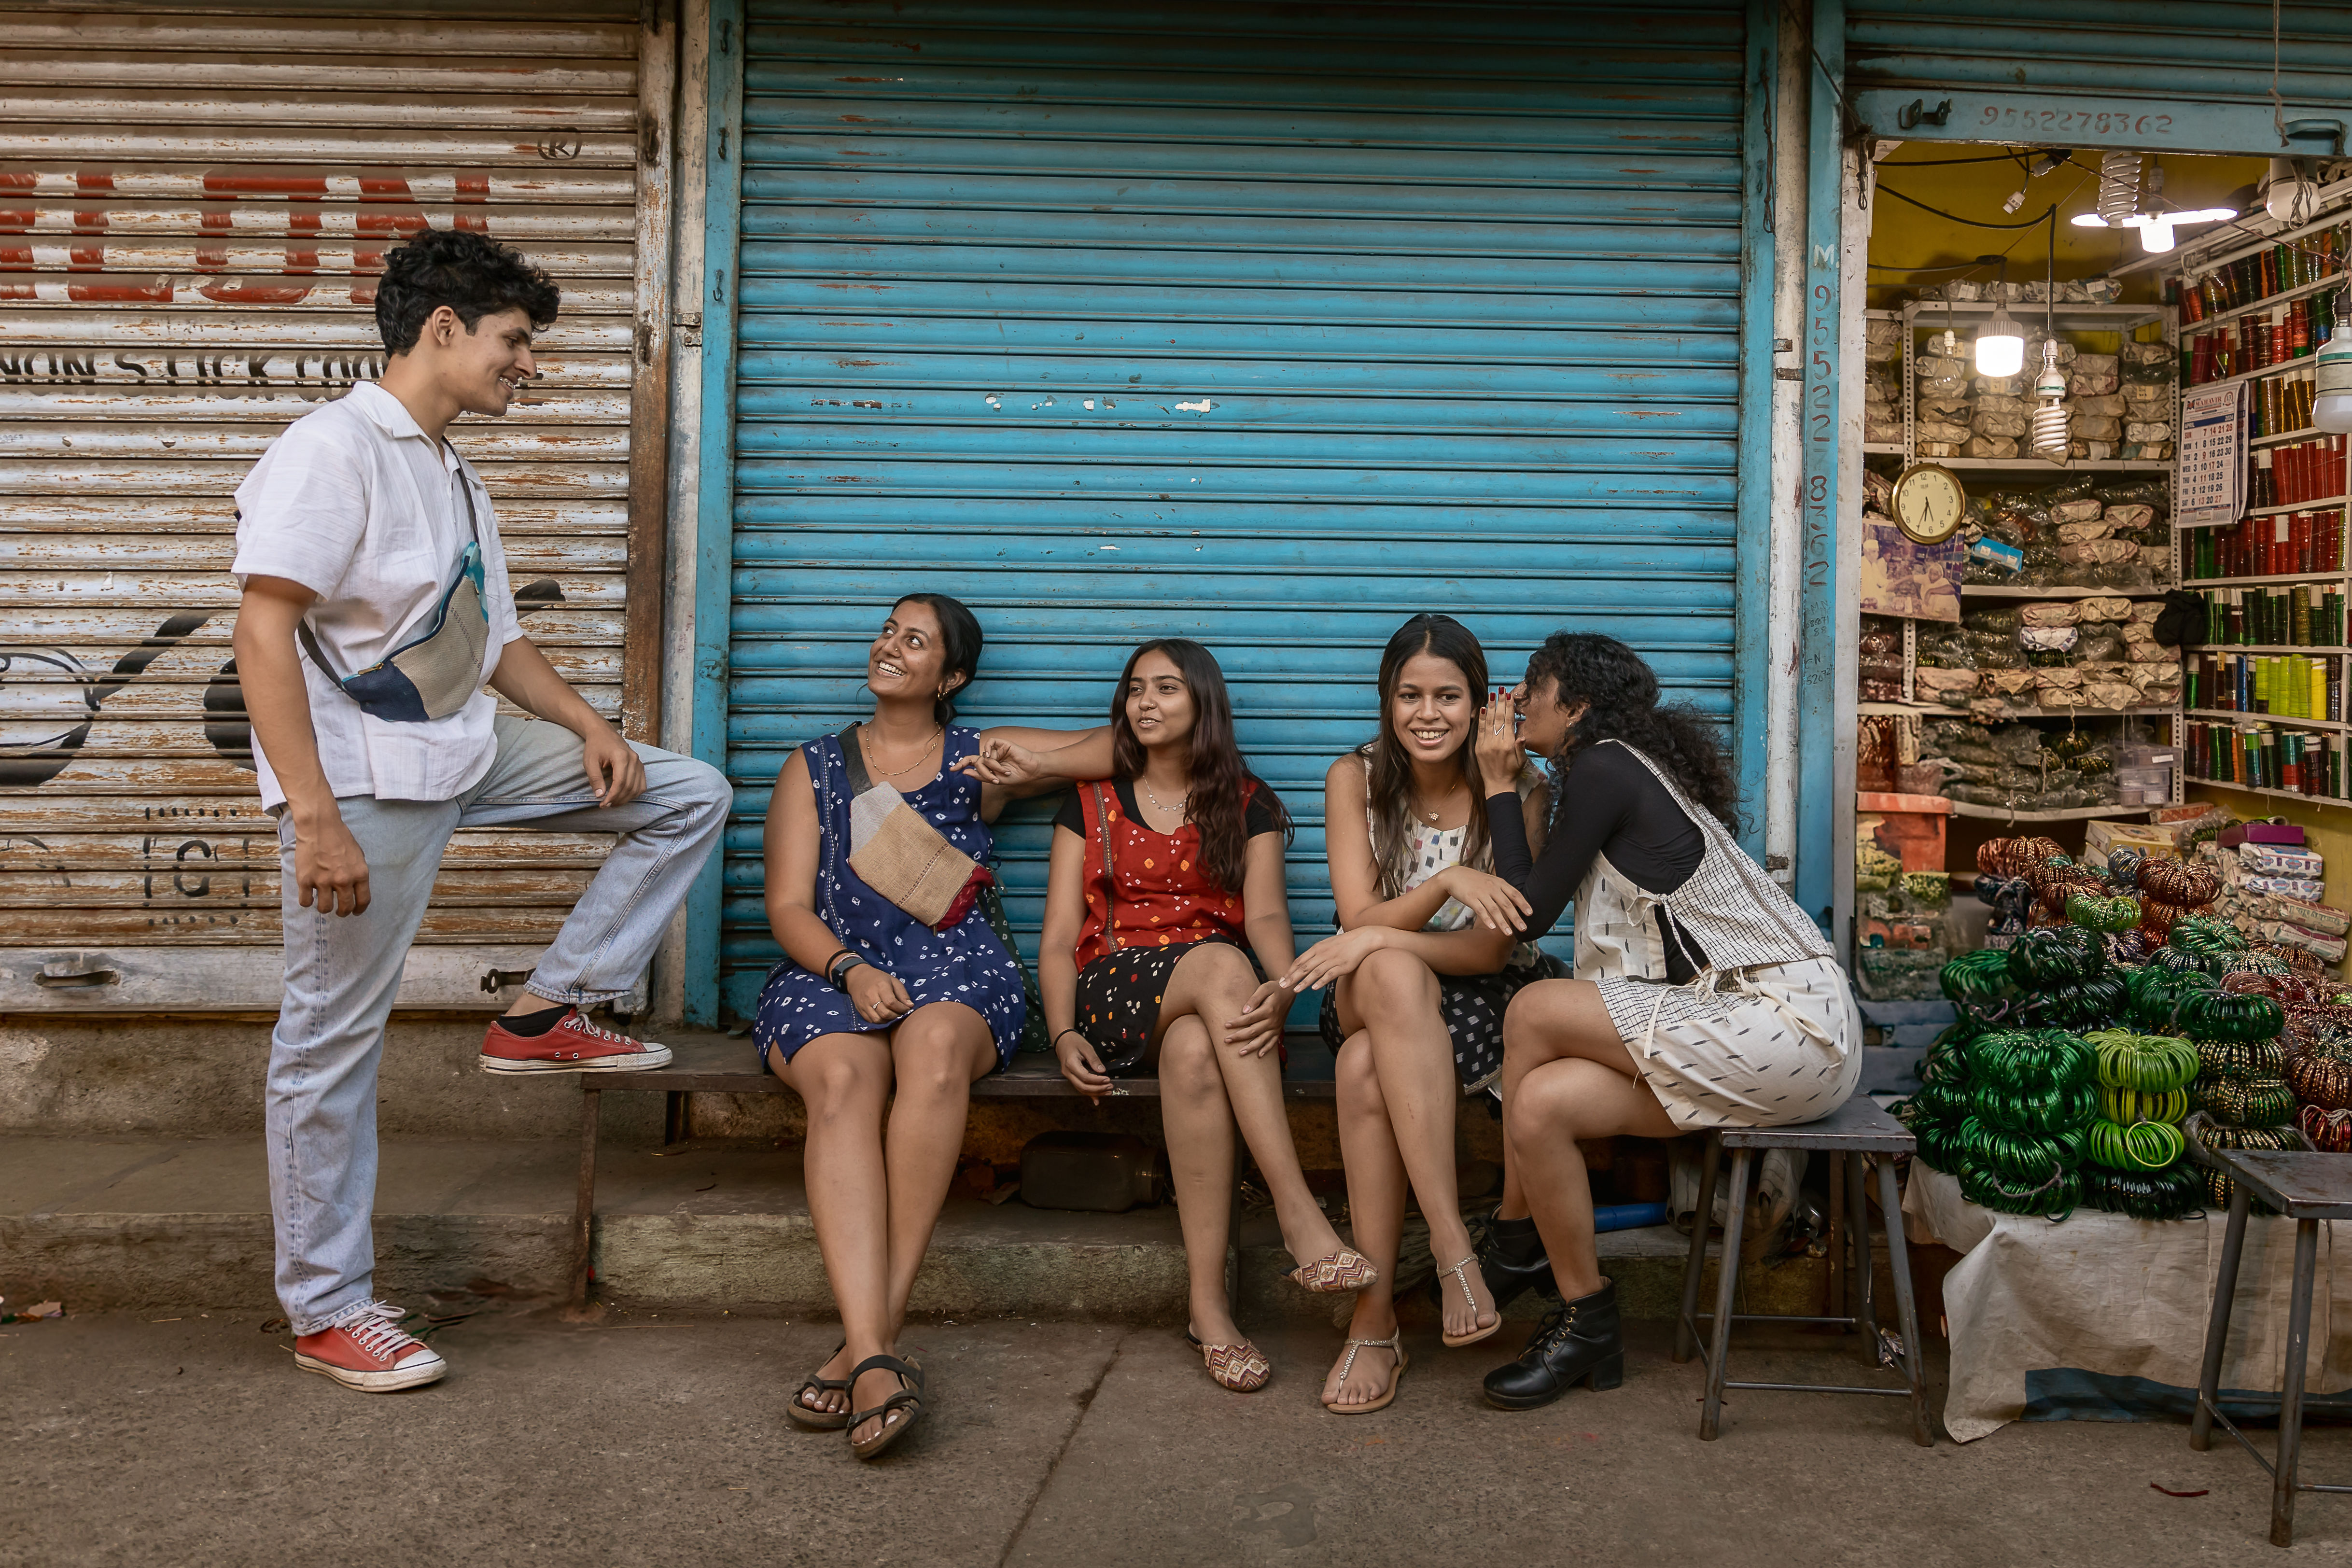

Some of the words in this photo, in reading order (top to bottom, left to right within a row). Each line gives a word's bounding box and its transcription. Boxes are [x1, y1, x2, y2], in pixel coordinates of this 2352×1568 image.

[1979, 106, 2172, 135] 9552278362
[114, 349, 280, 401] STICK
[2196, 396, 2222, 406] MAHAVIR
[2218, 425, 2224, 434] 21
[2226, 423, 2232, 432] 28
[2203, 440, 2206, 448] 8
[2217, 436, 2224, 445] 22
[2226, 435, 2232, 443] 29
[2217, 448, 2224, 457] 23
[2225, 447, 2231, 455] 30
[2201, 462, 2207, 471] 10
[2217, 460, 2223, 468] 24
[2216, 472, 2223, 480] 25
[2208, 484, 2214, 492] 19
[2216, 483, 2223, 491] 26
[2206, 496, 2213, 504] 20
[2215, 495, 2222, 503] 27
